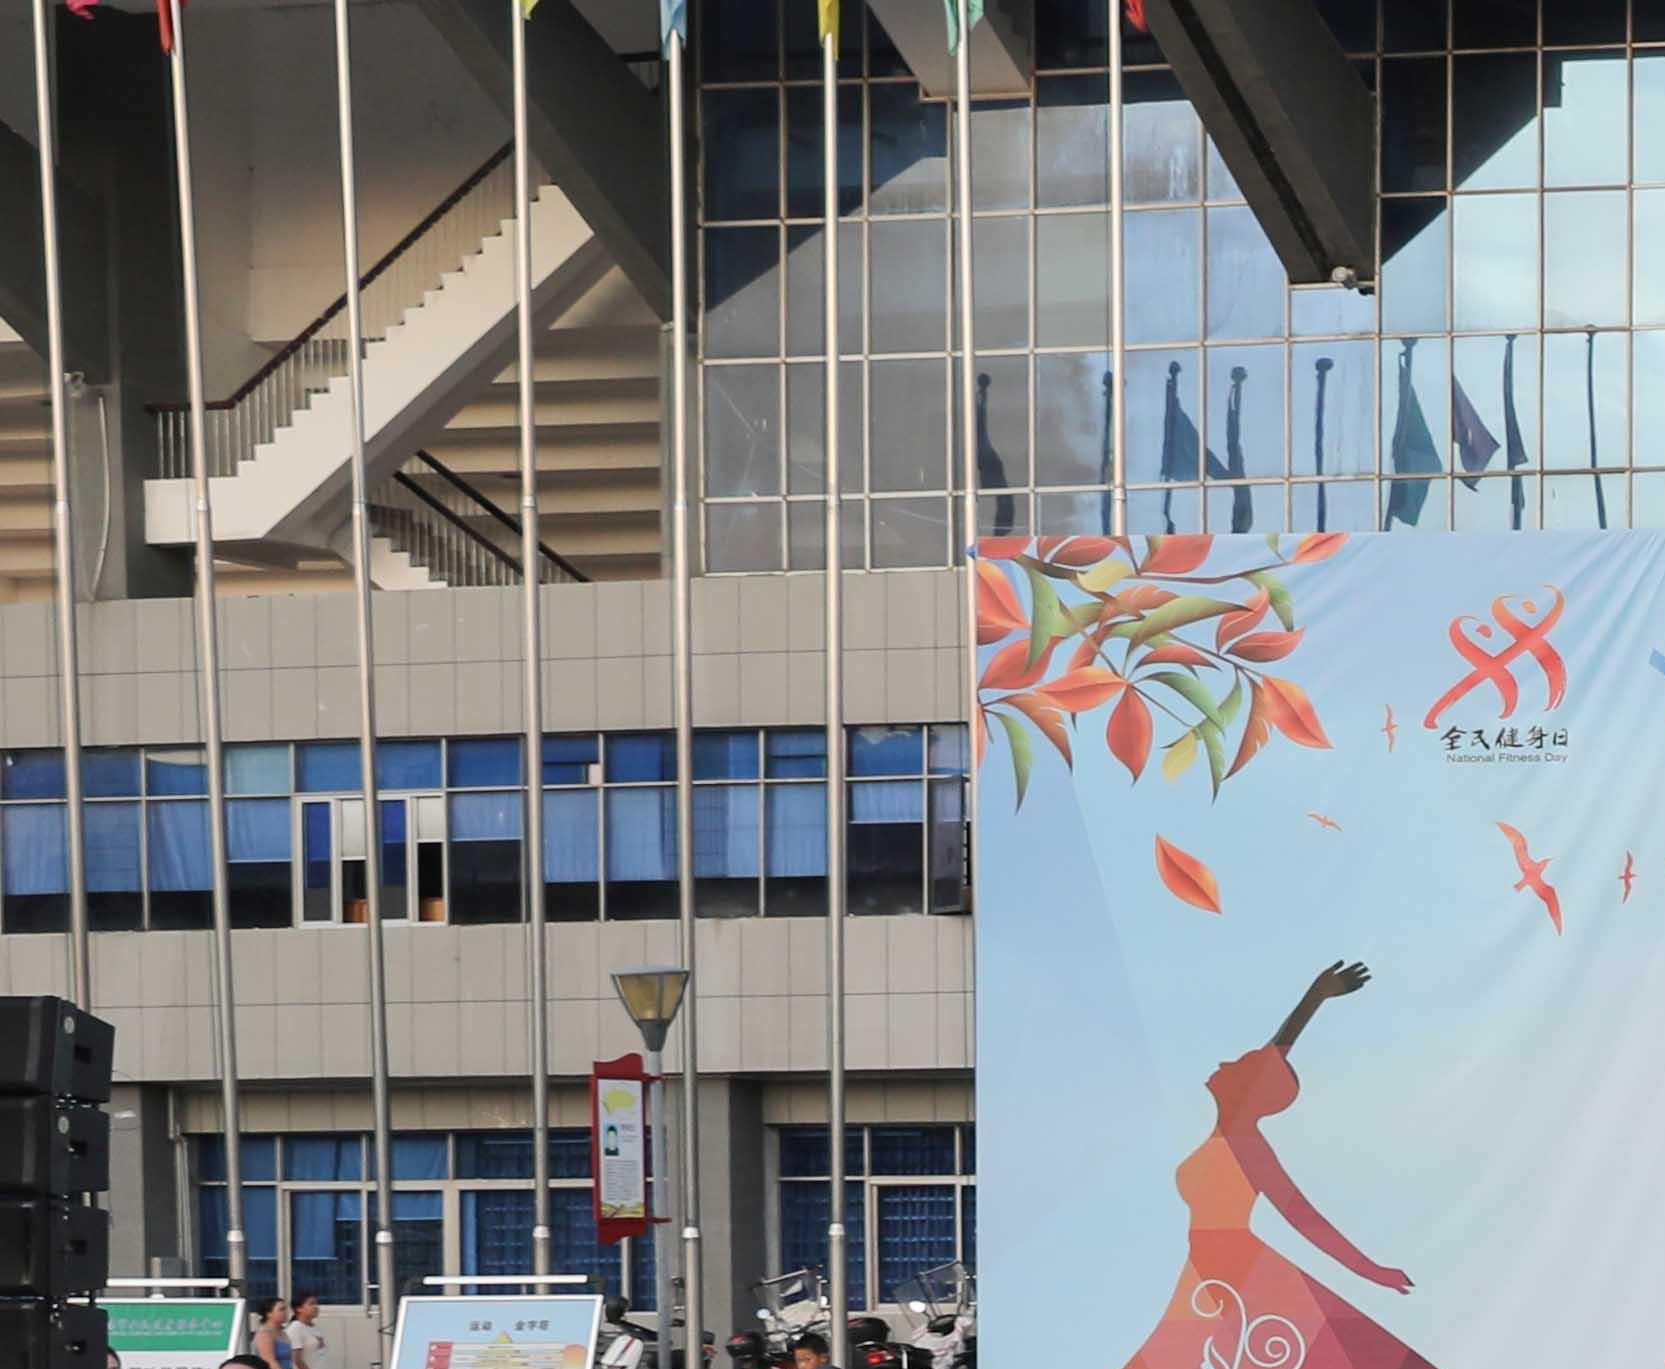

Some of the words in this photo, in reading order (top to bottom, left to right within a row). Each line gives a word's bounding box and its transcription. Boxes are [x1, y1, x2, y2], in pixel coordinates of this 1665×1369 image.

[1440, 725, 1568, 750] 全民健身日
[1446, 753, 1495, 763] National
[1499, 752, 1540, 762] Fitness
[1545, 752, 1568, 763] Day
